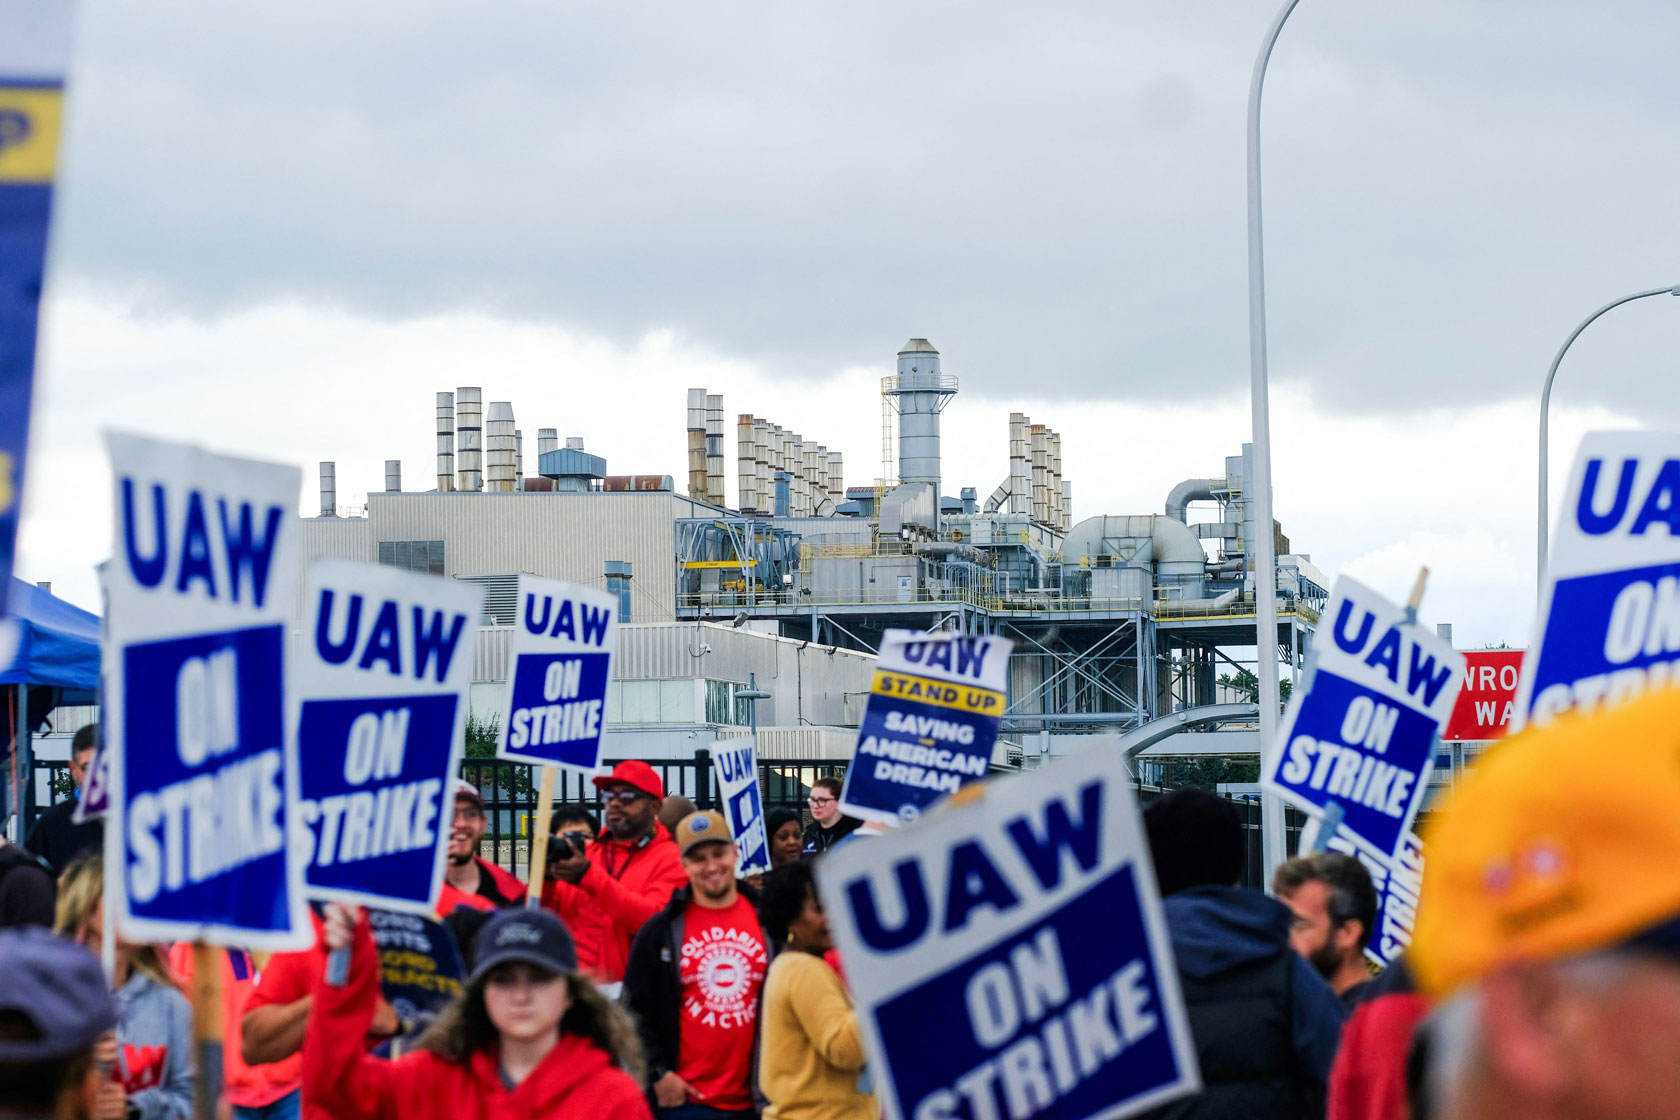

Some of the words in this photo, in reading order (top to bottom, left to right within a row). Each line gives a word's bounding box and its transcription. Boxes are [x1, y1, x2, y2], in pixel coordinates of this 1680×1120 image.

[121, 477, 283, 608] UAW
[315, 588, 466, 683] UAW
[525, 593, 610, 647] UAW
[904, 638, 991, 679] UAW
[1333, 598, 1451, 708] UAW
[543, 659, 582, 702] ON
[880, 677, 958, 704] STAND
[966, 693, 997, 710] UP
[343, 708, 411, 786] ON
[510, 699, 602, 749] STRIKE
[884, 711, 975, 745] SAVING
[1340, 696, 1399, 755] ON
[718, 747, 753, 783] UAW
[859, 736, 988, 776] AMERICAN
[874, 761, 962, 794] DREAM
[1282, 734, 1416, 818] STRIKE
[129, 749, 282, 903] STRIKE
[845, 778, 1106, 956] UAW
[684, 995, 703, 1018] IN
[965, 926, 1072, 1050] ON
